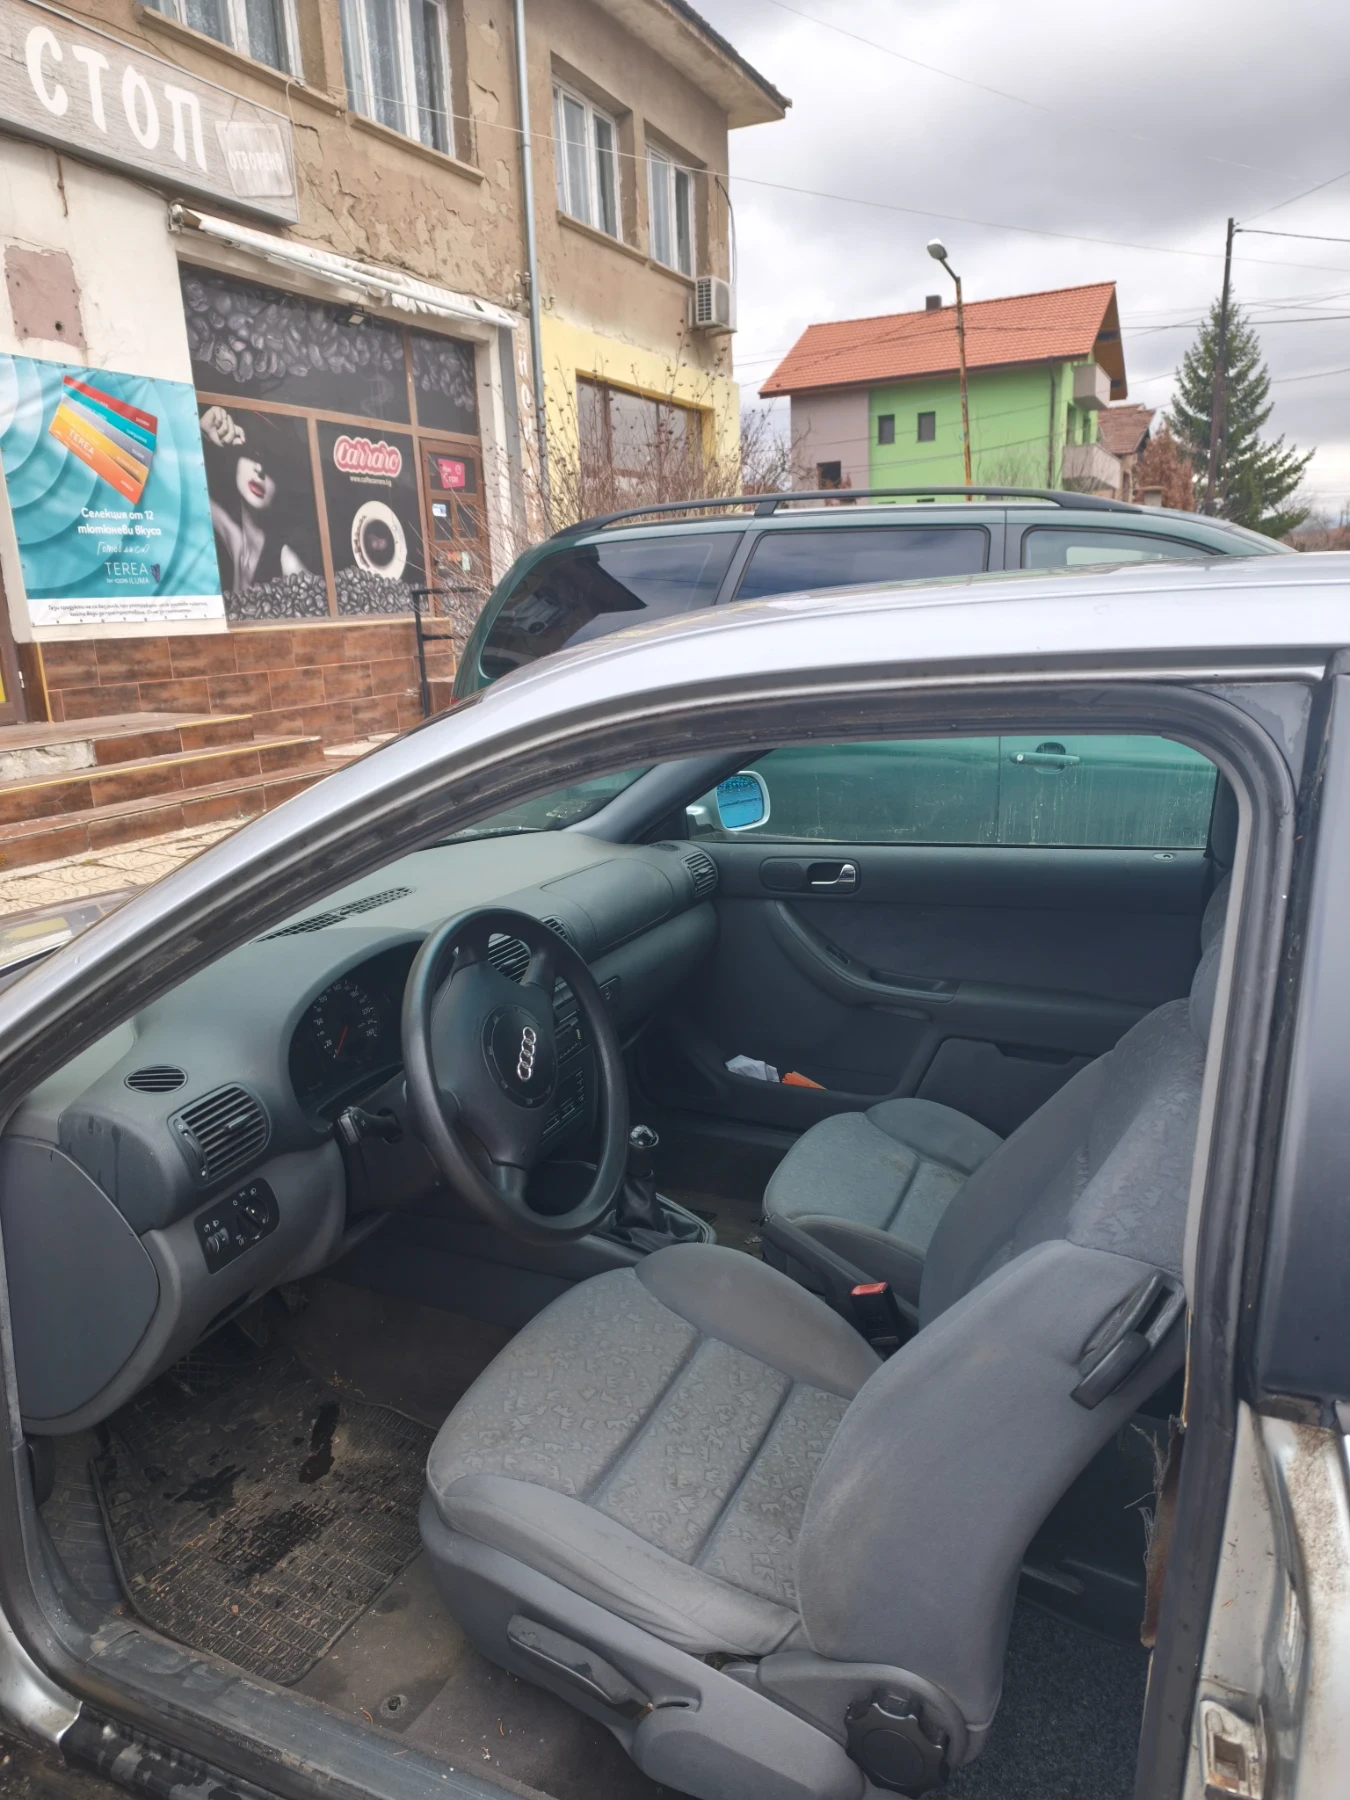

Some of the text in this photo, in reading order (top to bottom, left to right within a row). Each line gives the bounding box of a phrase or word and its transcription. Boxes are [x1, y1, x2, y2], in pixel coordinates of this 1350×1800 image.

[25, 25, 208, 174] СТОП
[69, 428, 94, 455] TEREA
[81, 507, 154, 520] Селекция от 12
[77, 523, 162, 538] тютюневи вкуса
[104, 561, 149, 576] TEREA
